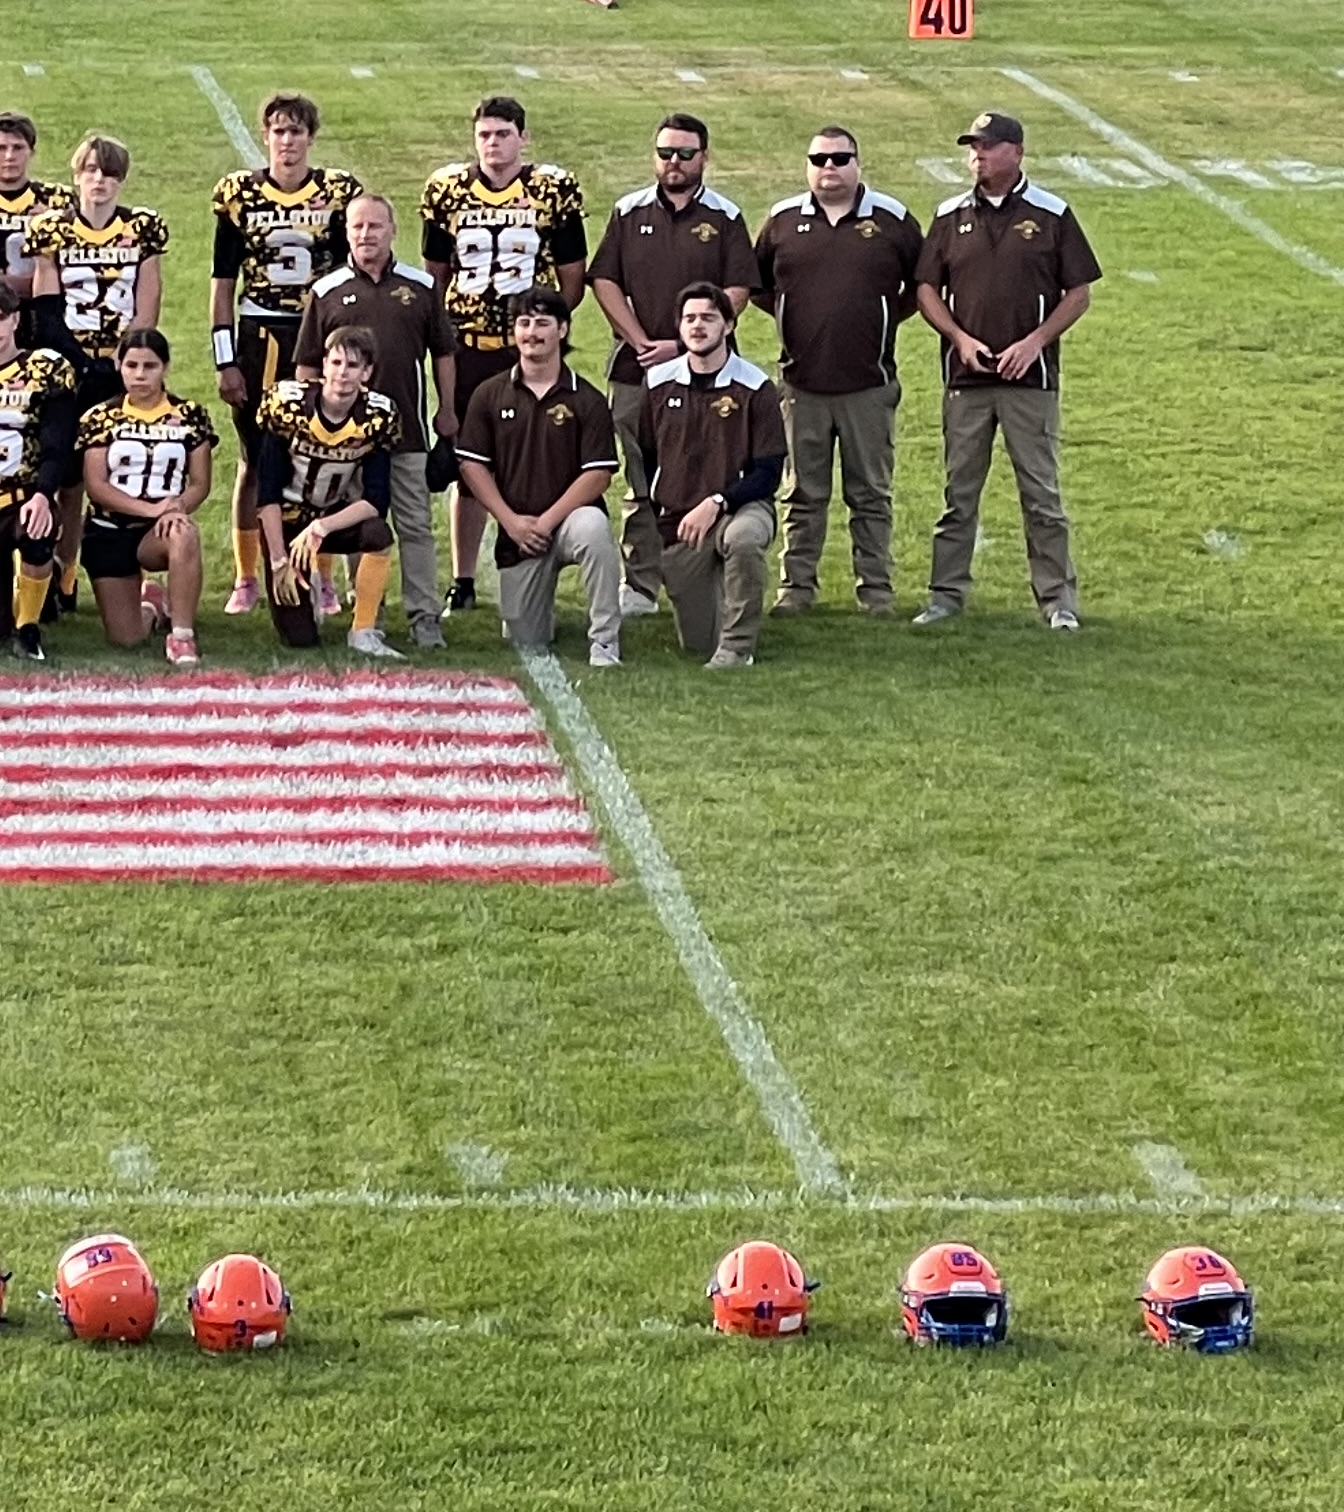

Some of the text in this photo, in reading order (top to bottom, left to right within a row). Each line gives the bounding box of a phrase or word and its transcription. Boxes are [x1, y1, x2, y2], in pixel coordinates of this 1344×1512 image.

[246, 210, 333, 228] PELLSTON
[458, 208, 537, 226] PELLSTON
[59, 246, 139, 264] PELLSTON
[455, 227, 541, 295] 99
[111, 422, 190, 442] PELLSTON
